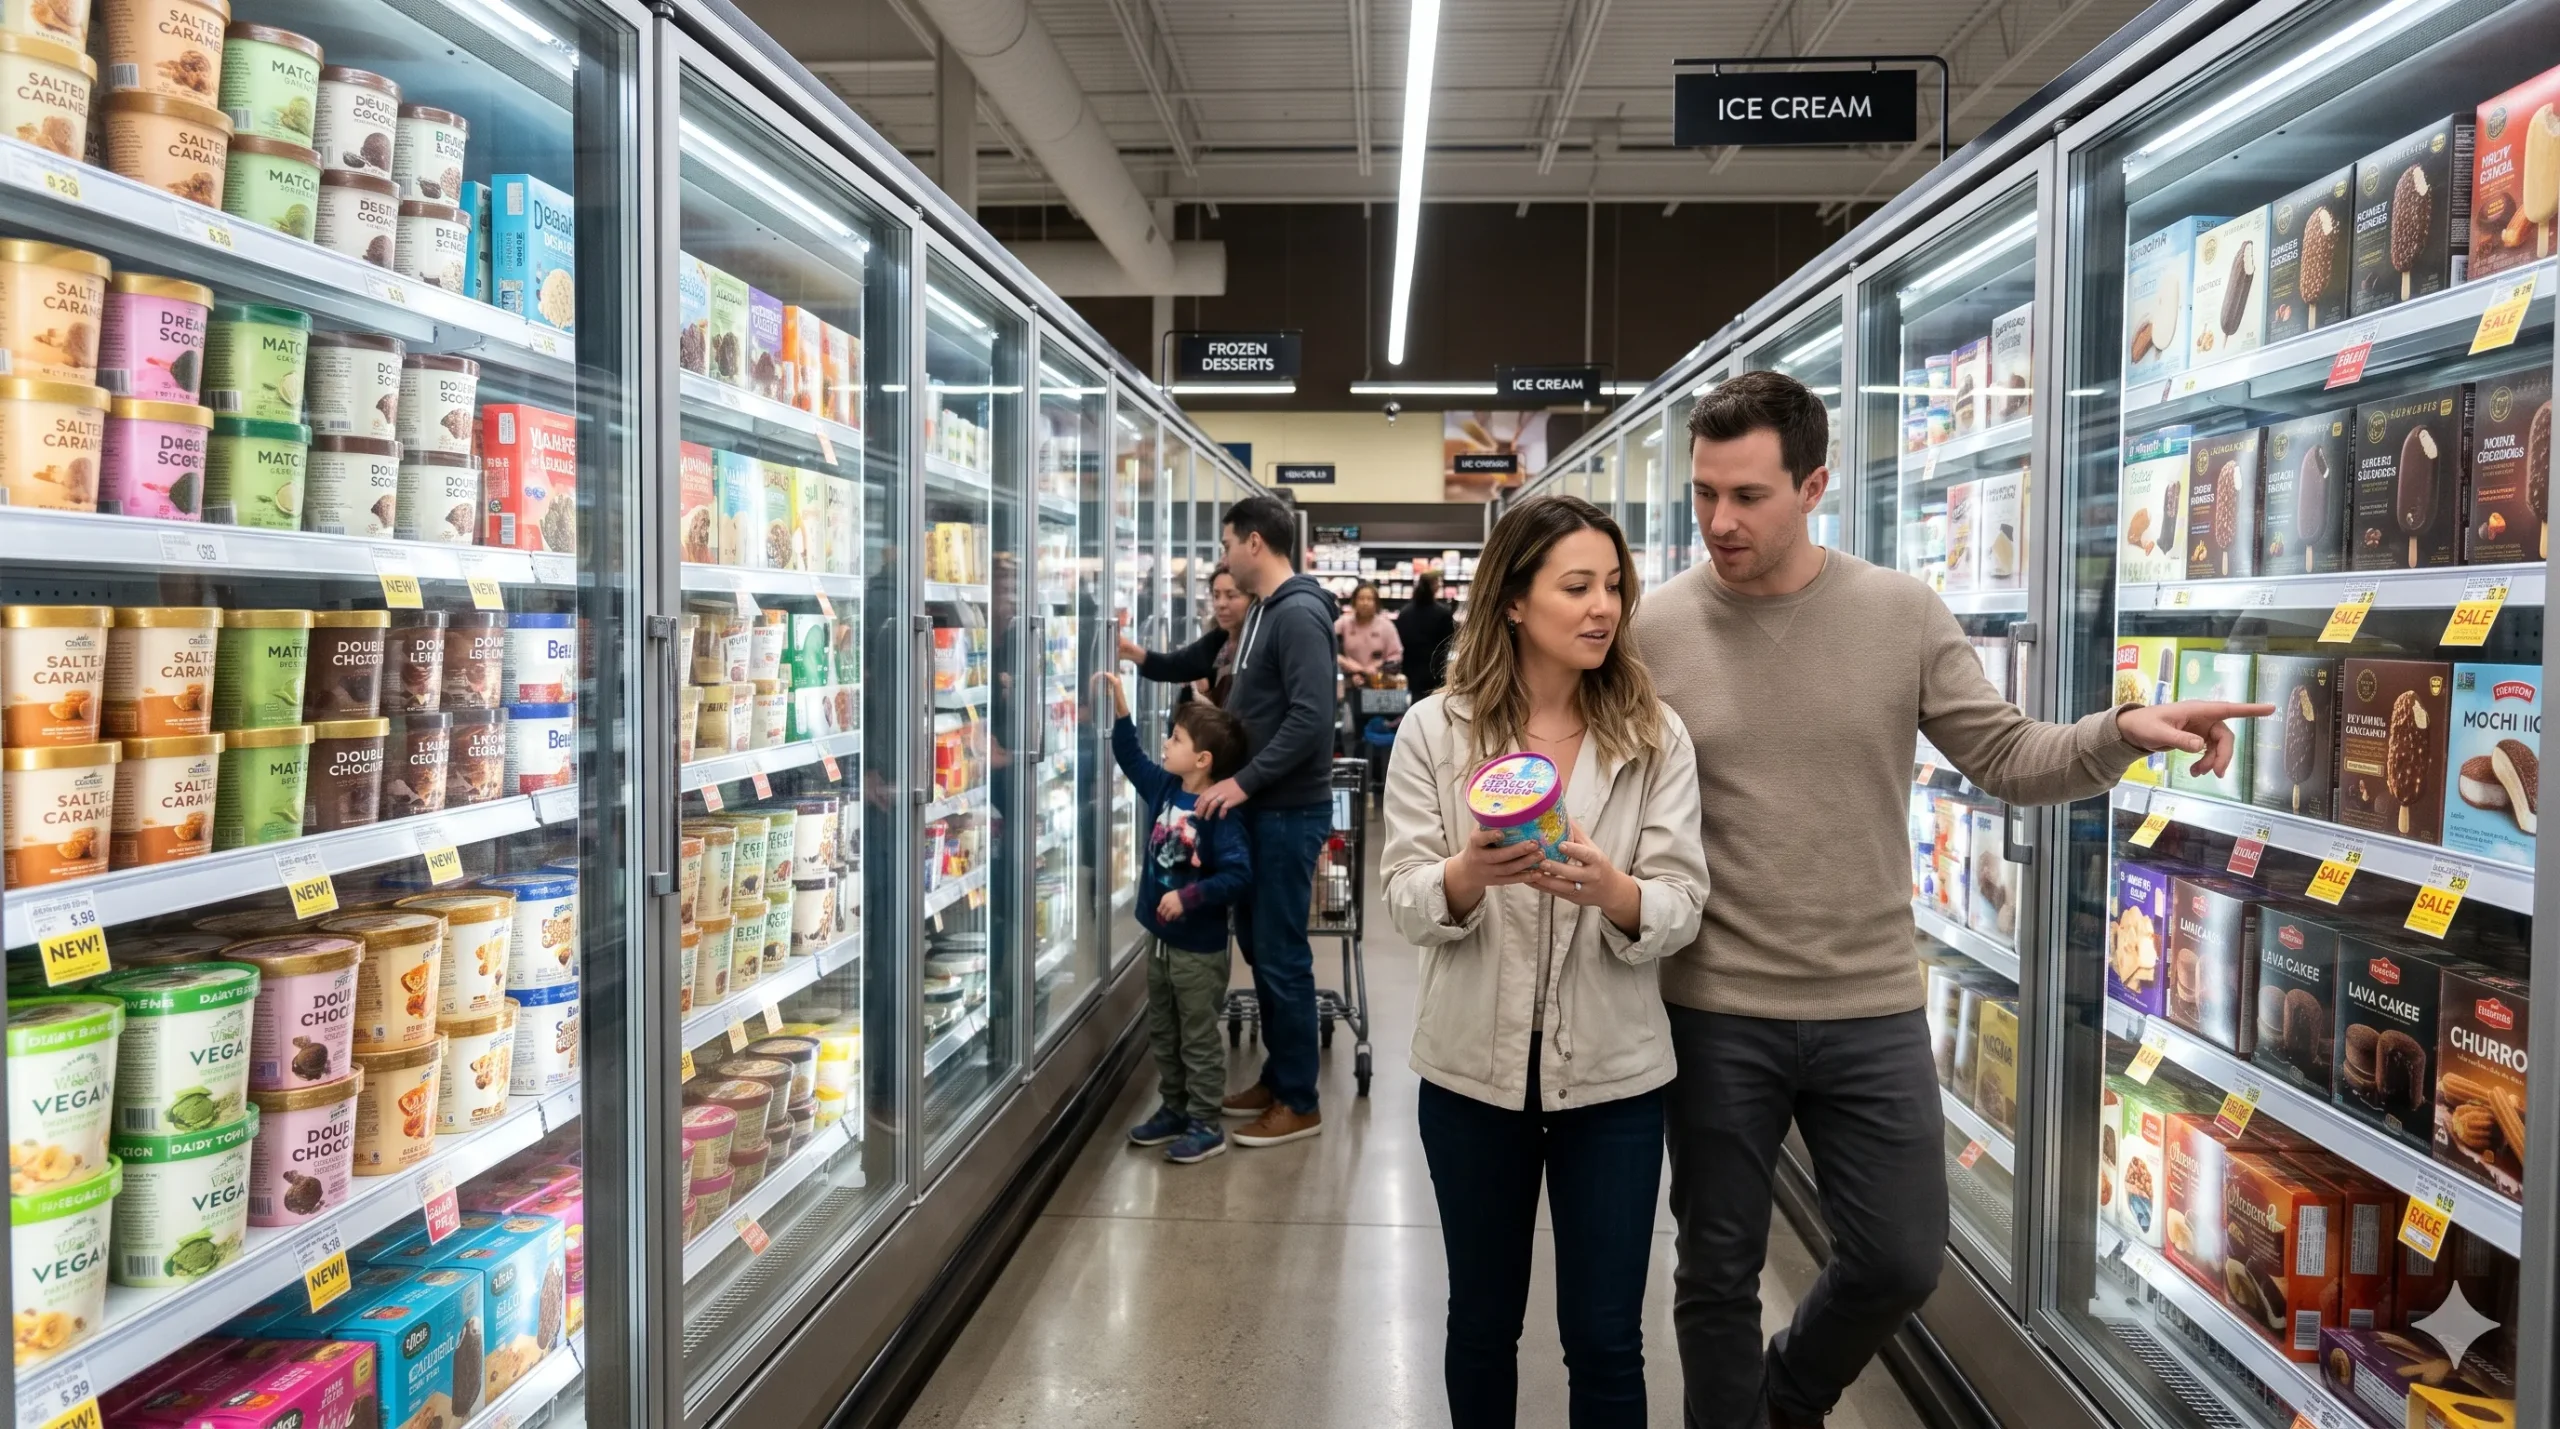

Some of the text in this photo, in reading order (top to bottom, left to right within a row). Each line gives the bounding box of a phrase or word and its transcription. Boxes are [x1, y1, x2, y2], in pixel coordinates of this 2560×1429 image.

[28, 72, 86, 100] SALTED
[1718, 95, 1873, 121] ICE CREAM
[2481, 310, 2515, 332] SALE
[1208, 342, 1268, 356] FROZEN
[1202, 358, 1275, 371] DESSERTS
[1512, 378, 1584, 391] ICE CREAM
[2331, 611, 2363, 625] SALE
[2454, 610, 2493, 625] SALE
[2463, 711, 2517, 731] MOCHI
[430, 850, 457, 869] NEW!
[2318, 866, 2350, 886] SALE
[295, 881, 329, 903] NEW!
[2417, 893, 2455, 916] SALE
[49, 935, 101, 963] NEW!
[2262, 948, 2320, 982] LAVA CAKEE
[2349, 981, 2420, 1022] LAVA CAKEE
[2450, 1026, 2528, 1073] CHURRO
[311, 1262, 345, 1291] NEW!
